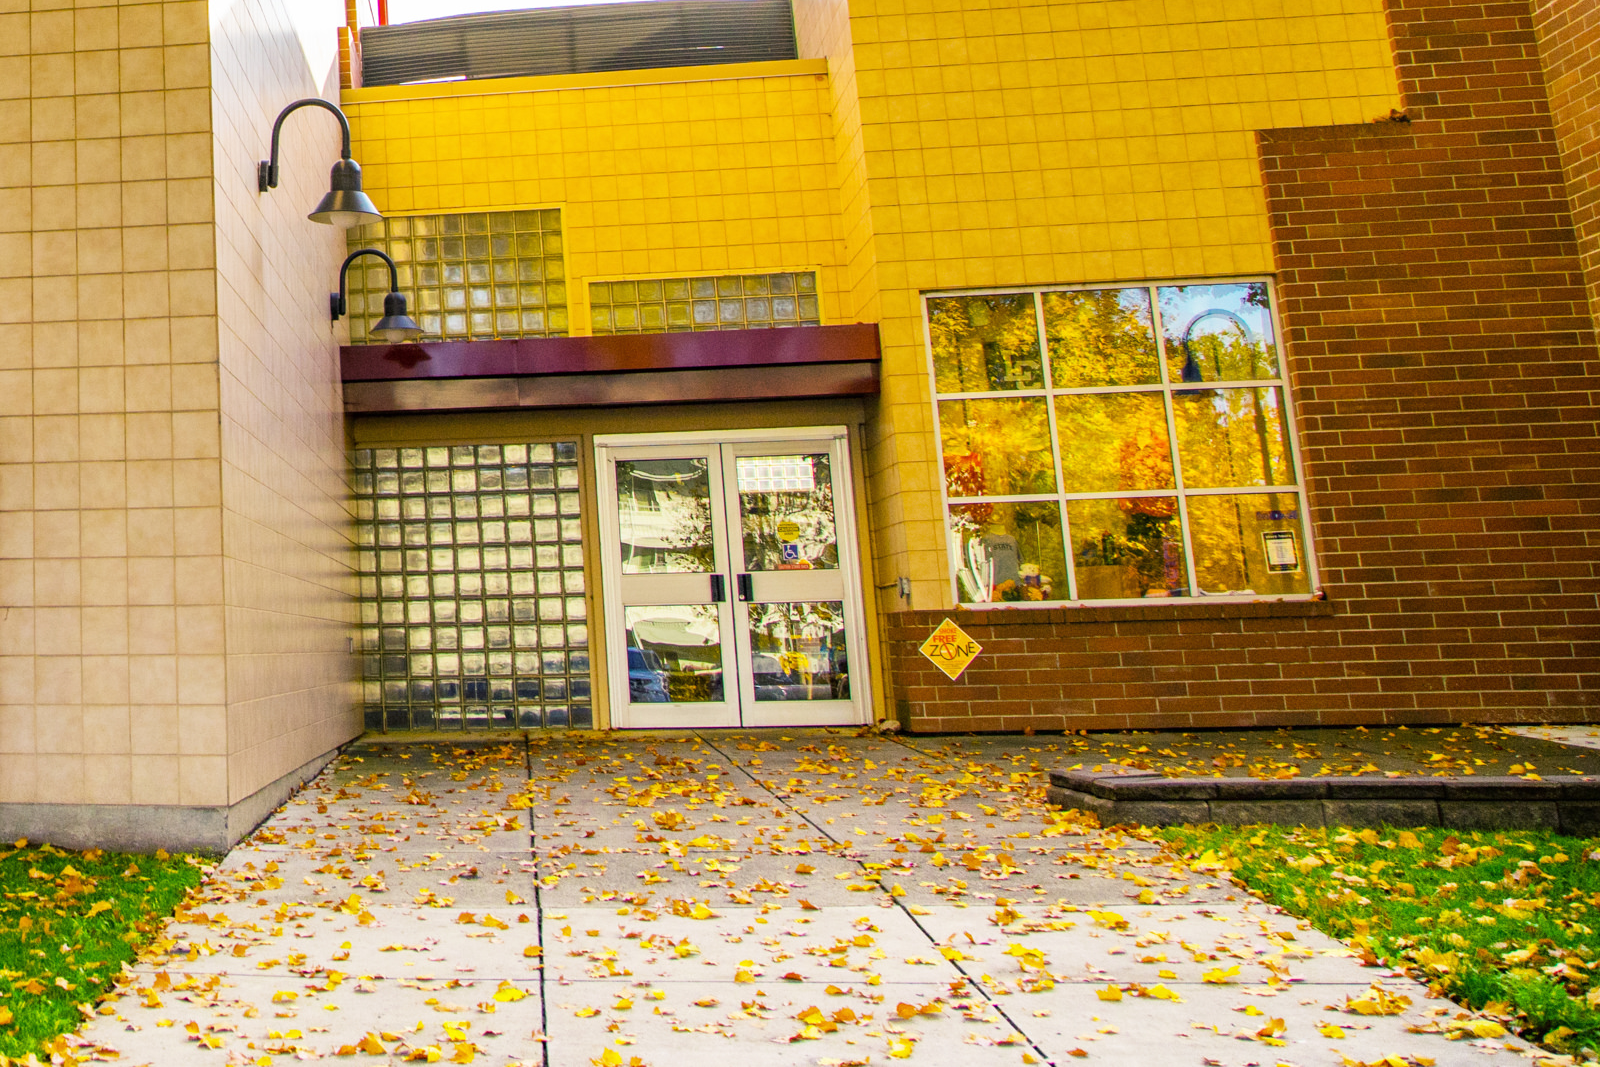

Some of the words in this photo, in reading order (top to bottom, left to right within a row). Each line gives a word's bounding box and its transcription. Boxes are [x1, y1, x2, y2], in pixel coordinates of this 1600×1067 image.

[993, 543, 1013, 551] STATE
[933, 635, 957, 643] FREE
[929, 642, 976, 661] ZONE
